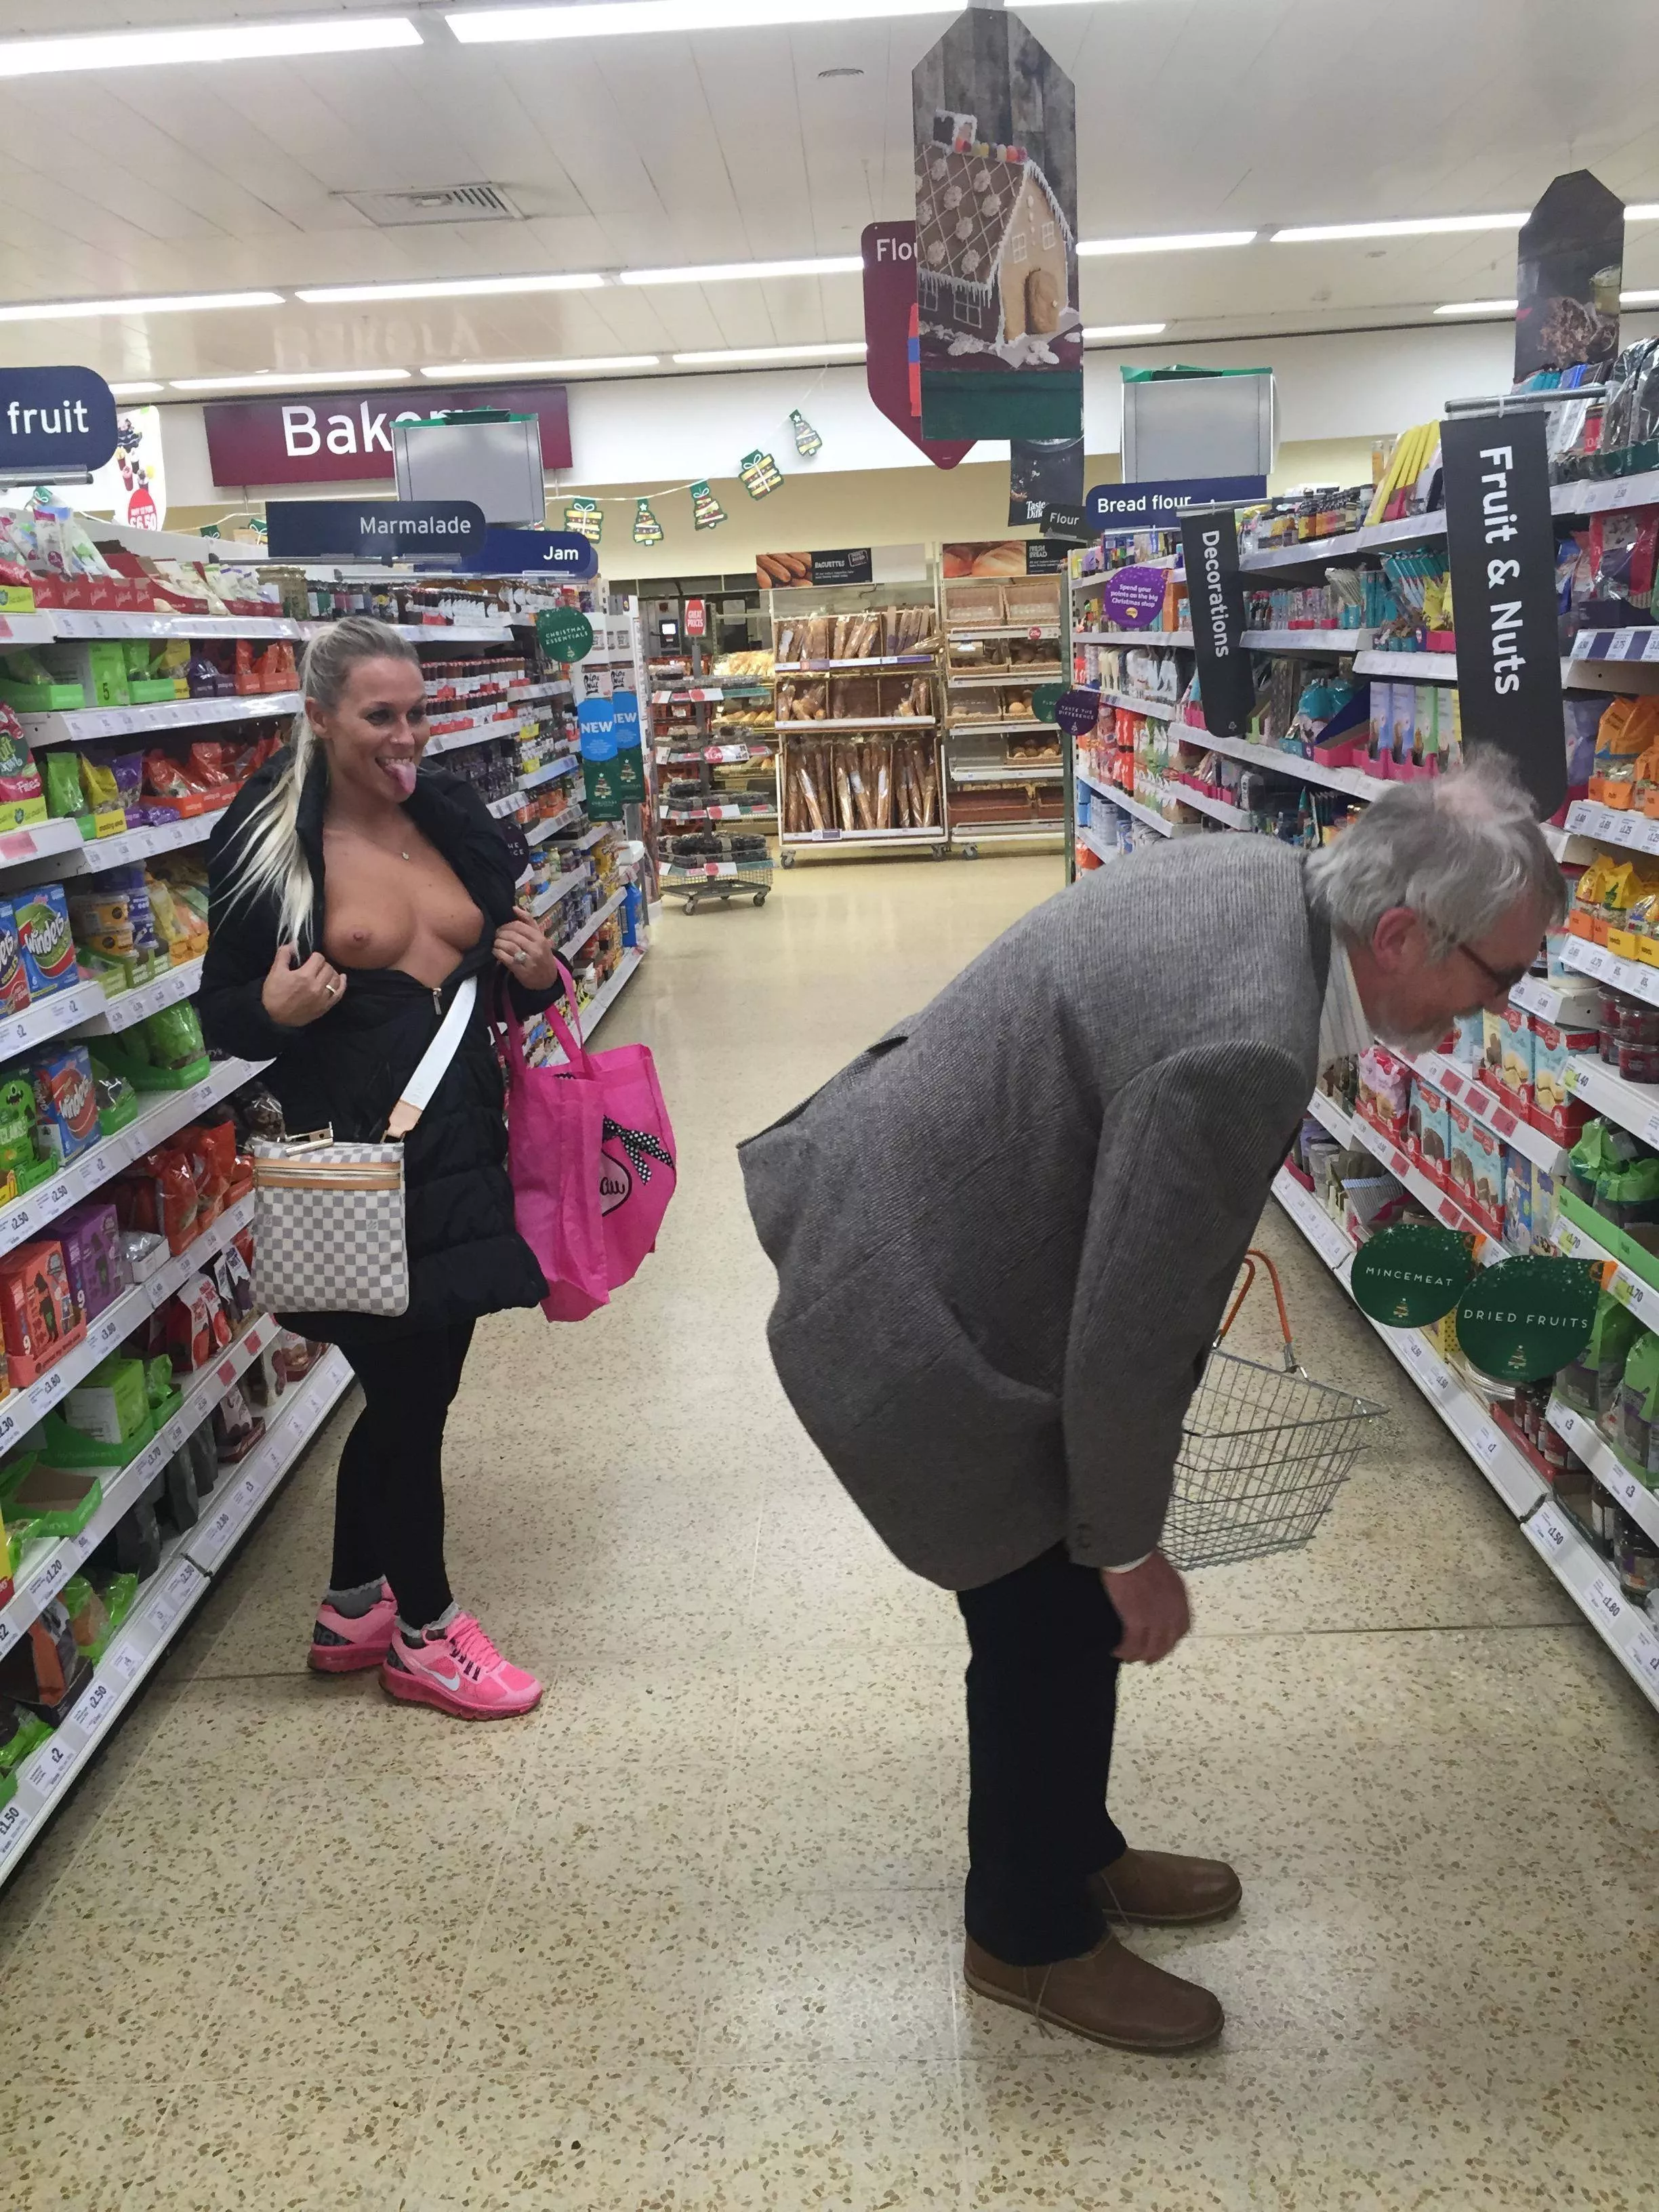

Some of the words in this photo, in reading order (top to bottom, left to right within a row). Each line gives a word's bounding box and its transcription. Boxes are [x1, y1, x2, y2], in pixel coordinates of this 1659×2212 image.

[877, 238, 918, 262] Flo
[7, 401, 89, 436] fruit
[1098, 496, 1146, 513] Bread
[1153, 494, 1191, 511] flour
[1479, 445, 1520, 544] Fruit
[1026, 501, 1046, 511] Taste
[360, 516, 471, 535] Marmalade
[1050, 512, 1080, 525] Flour
[544, 546, 579, 561] Jam
[815, 560, 845, 569] BAGUETTES
[1487, 558, 1521, 589] &
[1111, 597, 1140, 606] Christmas
[1201, 530, 1230, 657] Decorations
[546, 625, 585, 638] CHRISTMAS
[546, 631, 588, 644] ESSENTIALS
[1490, 600, 1526, 695] Nuts
[1059, 710, 1094, 720] DIFFERENCE
[1061, 705, 1079, 713] TASTE
[580, 720, 613, 733] NEW
[52, 1185, 68, 1203] £2.50
[12, 1212, 29, 1230] £2.50
[1366, 1267, 1453, 1287] MINCEMEAT
[77, 1290, 85, 1309] 9
[1627, 1284, 1643, 1303] £1.70
[1464, 1309, 1517, 1323] DRIED
[1526, 1313, 1589, 1329] FRUITS
[23, 1334, 31, 1355] 9
[45, 1374, 61, 1394] £3.80
[1548, 1528, 1564, 1546] £1.50
[45, 1559, 62, 1584] £1.20
[1603, 1597, 1620, 1617] £1.80
[89, 1685, 107, 1708] £2.50
[52, 1747, 64, 1763] £2
